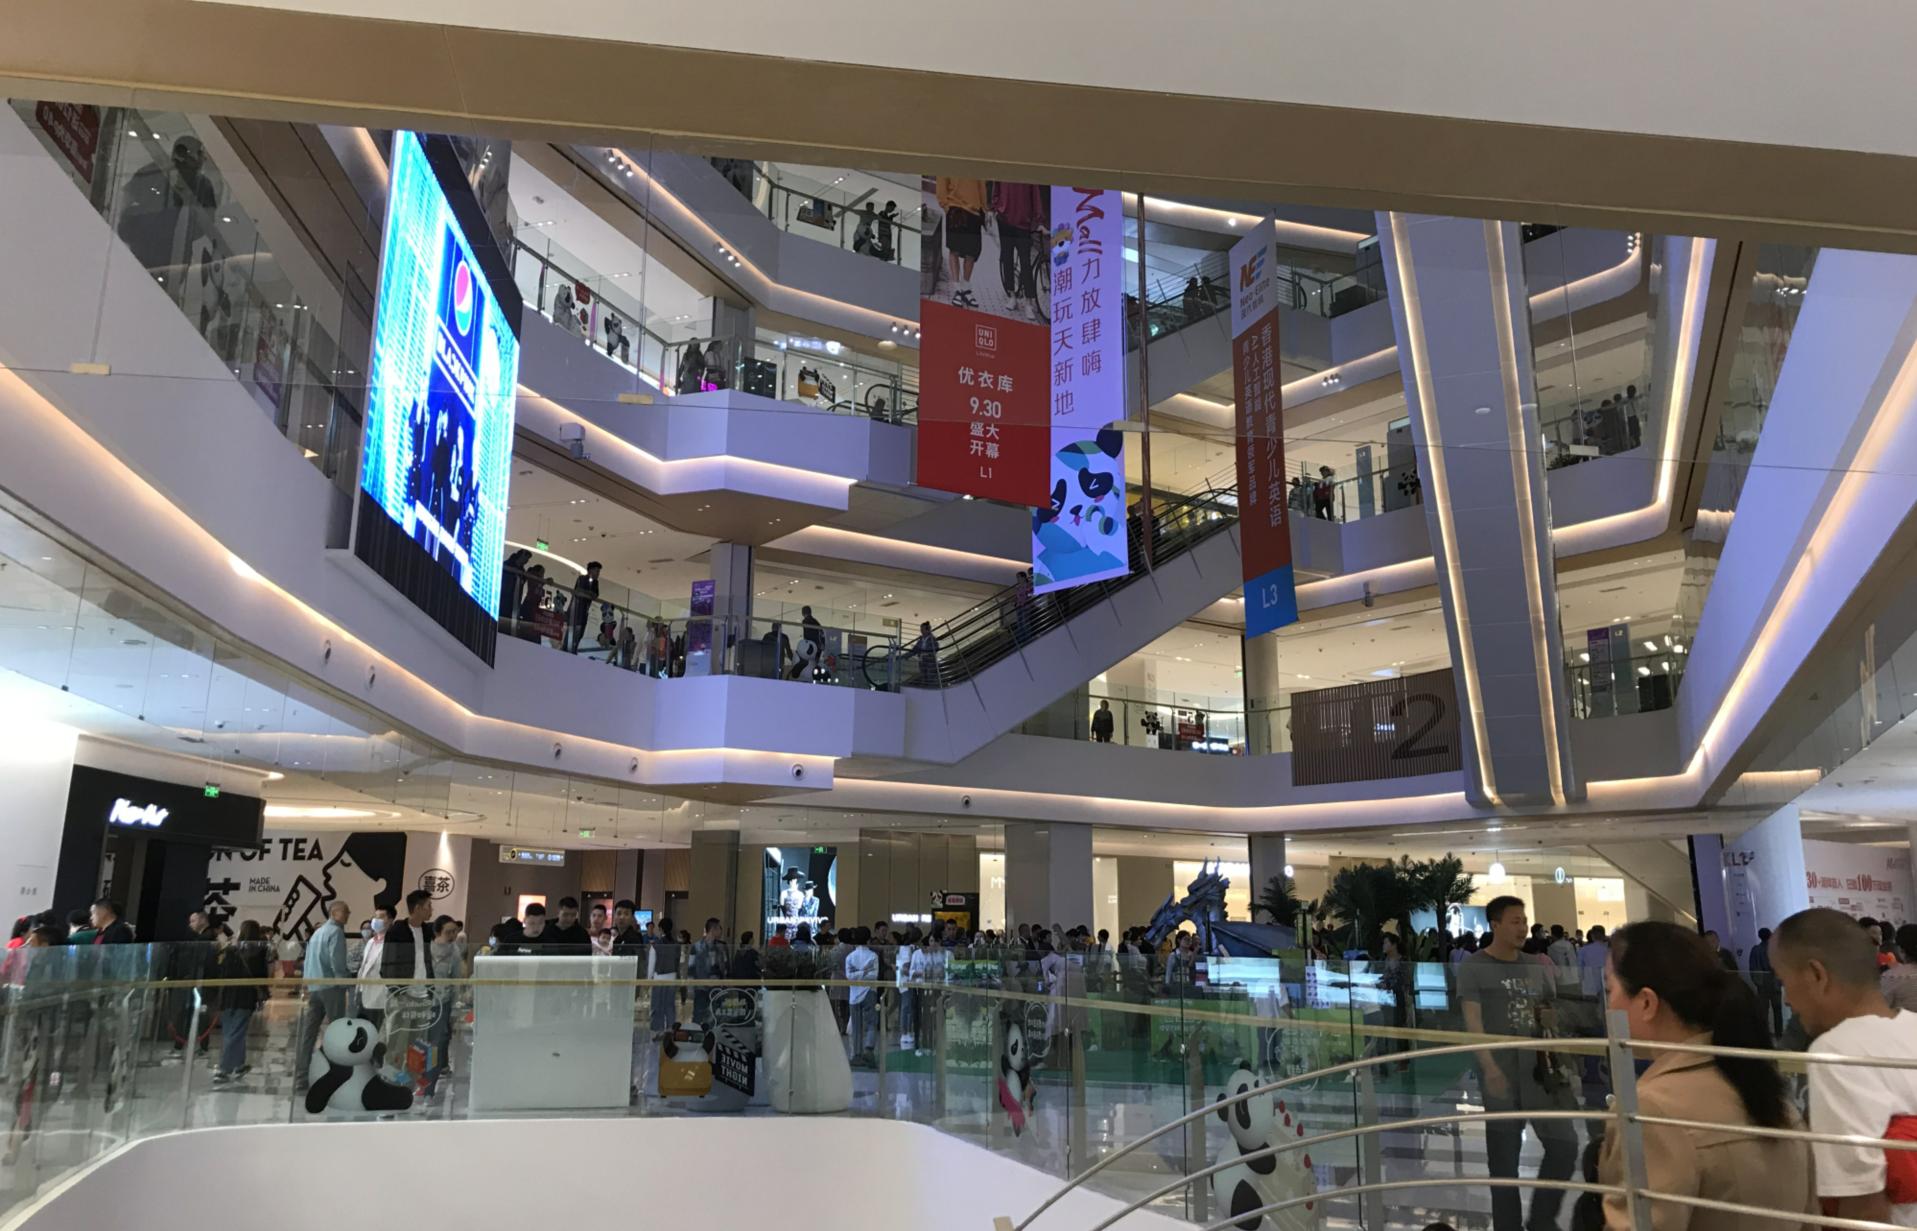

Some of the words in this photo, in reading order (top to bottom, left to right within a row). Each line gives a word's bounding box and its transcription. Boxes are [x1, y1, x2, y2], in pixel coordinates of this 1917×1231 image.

[1080, 257, 1102, 376] 力放肆嗨
[978, 328, 993, 339] UNI
[978, 337, 994, 347] QLO
[1053, 266, 1074, 416] 潮玩天新地
[958, 366, 1014, 393] 优衣库
[969, 396, 1002, 419] 9.30
[970, 421, 1000, 440] 盛大
[1261, 323, 1282, 528] 香港现代青少儿英语
[969, 439, 1000, 459] 开幕
[1261, 582, 1279, 609] L3
[1392, 693, 1447, 761] 2
[278, 837, 324, 862] TEA
[249, 877, 271, 885] MADE
[249, 885, 256, 893] IN
[257, 884, 281, 893] CHINA
[423, 875, 451, 894] 喜茶
